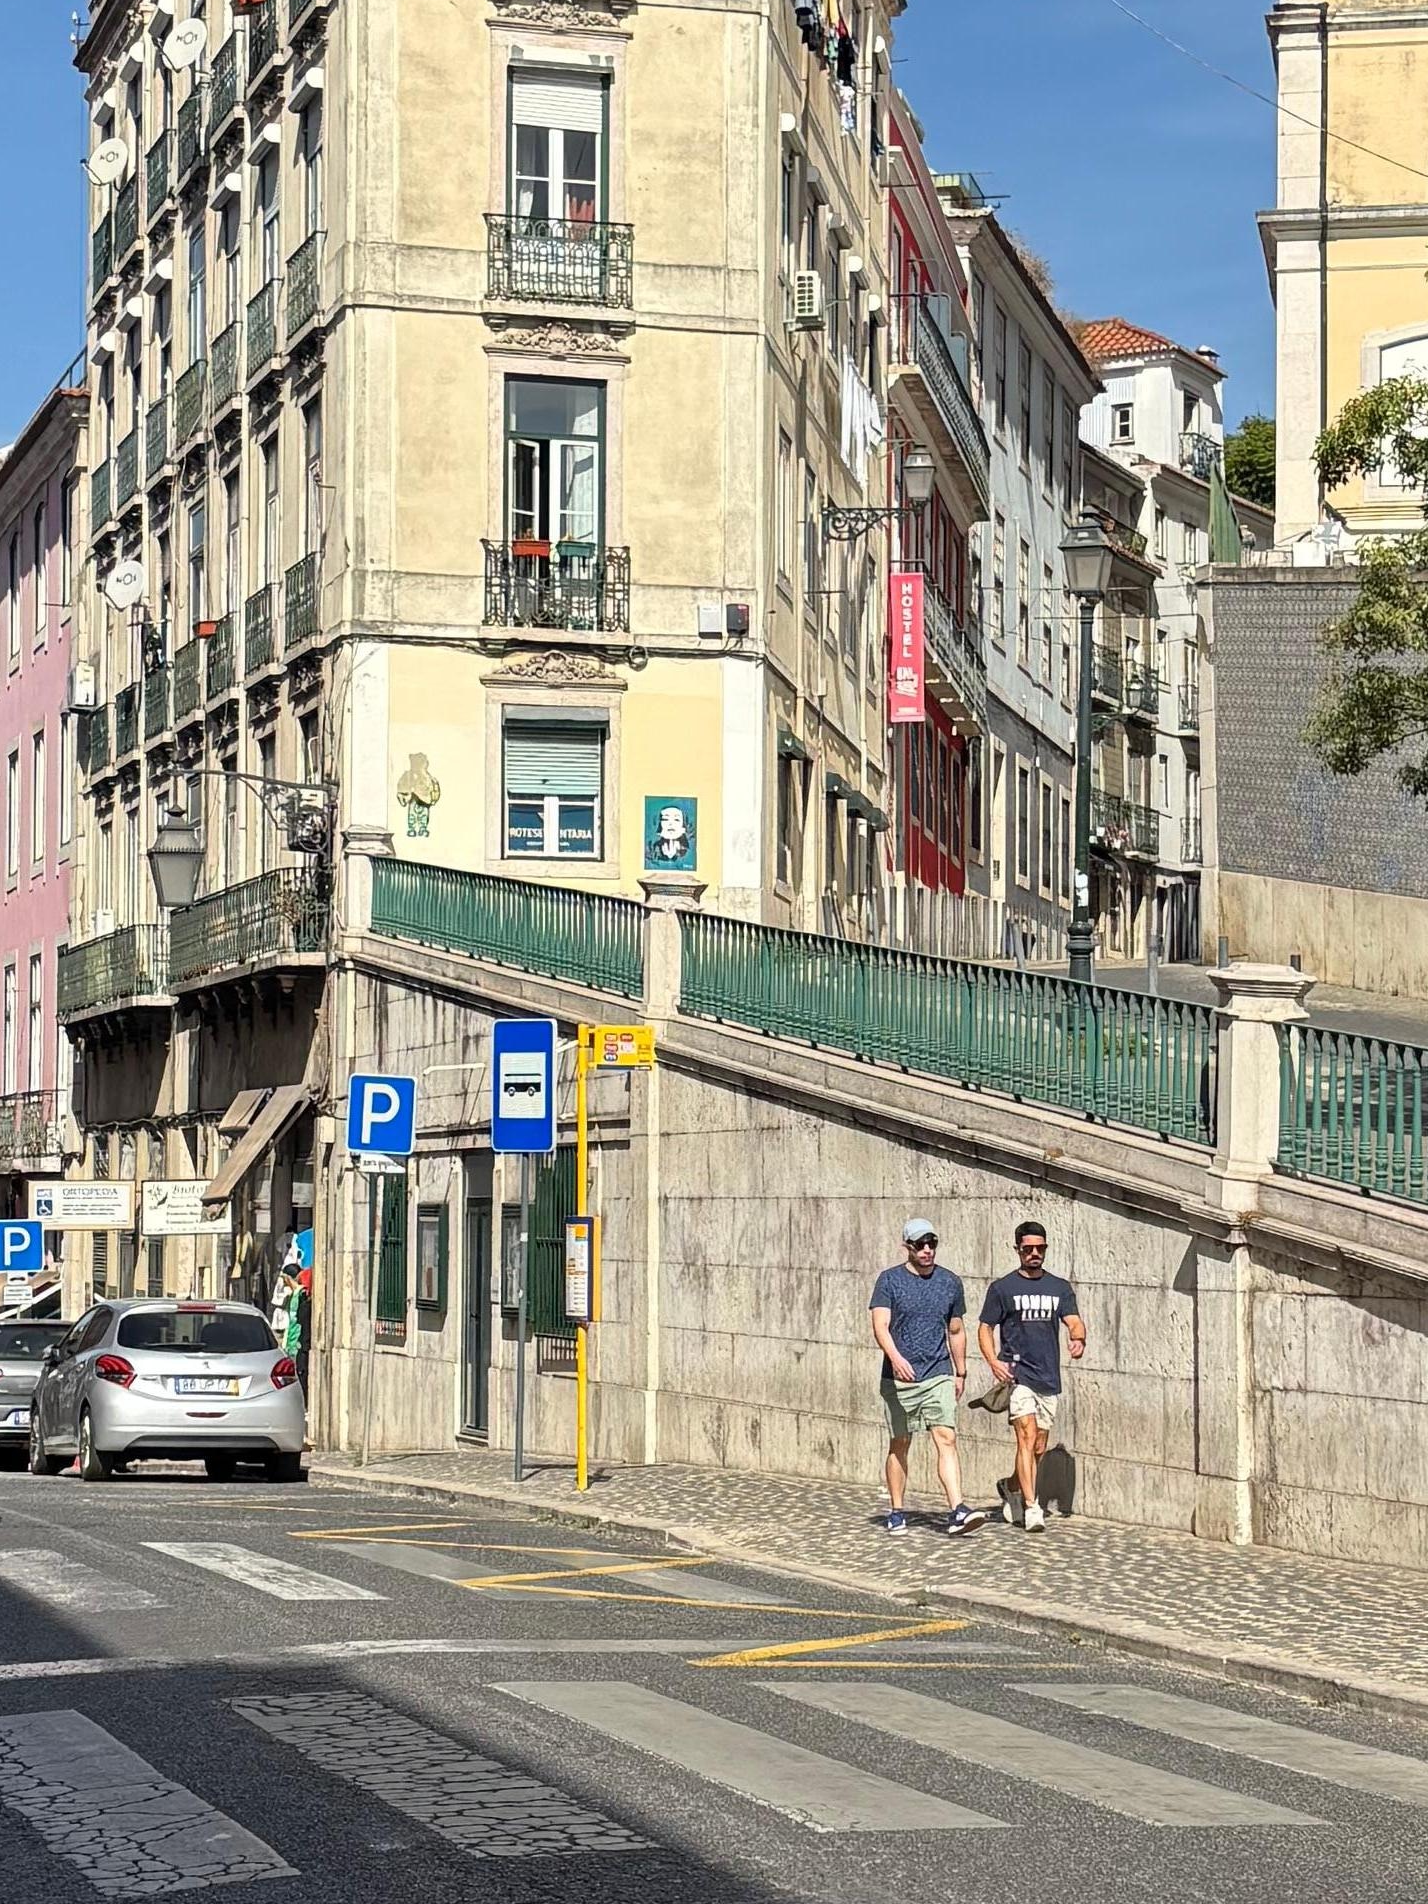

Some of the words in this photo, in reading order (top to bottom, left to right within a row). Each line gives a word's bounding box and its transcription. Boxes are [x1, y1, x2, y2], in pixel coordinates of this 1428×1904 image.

[901, 582, 913, 658] HOSTEL
[361, 1083, 400, 1144] P
[4, 1227, 31, 1266] P
[1013, 1295, 1060, 1311] TOMMY
